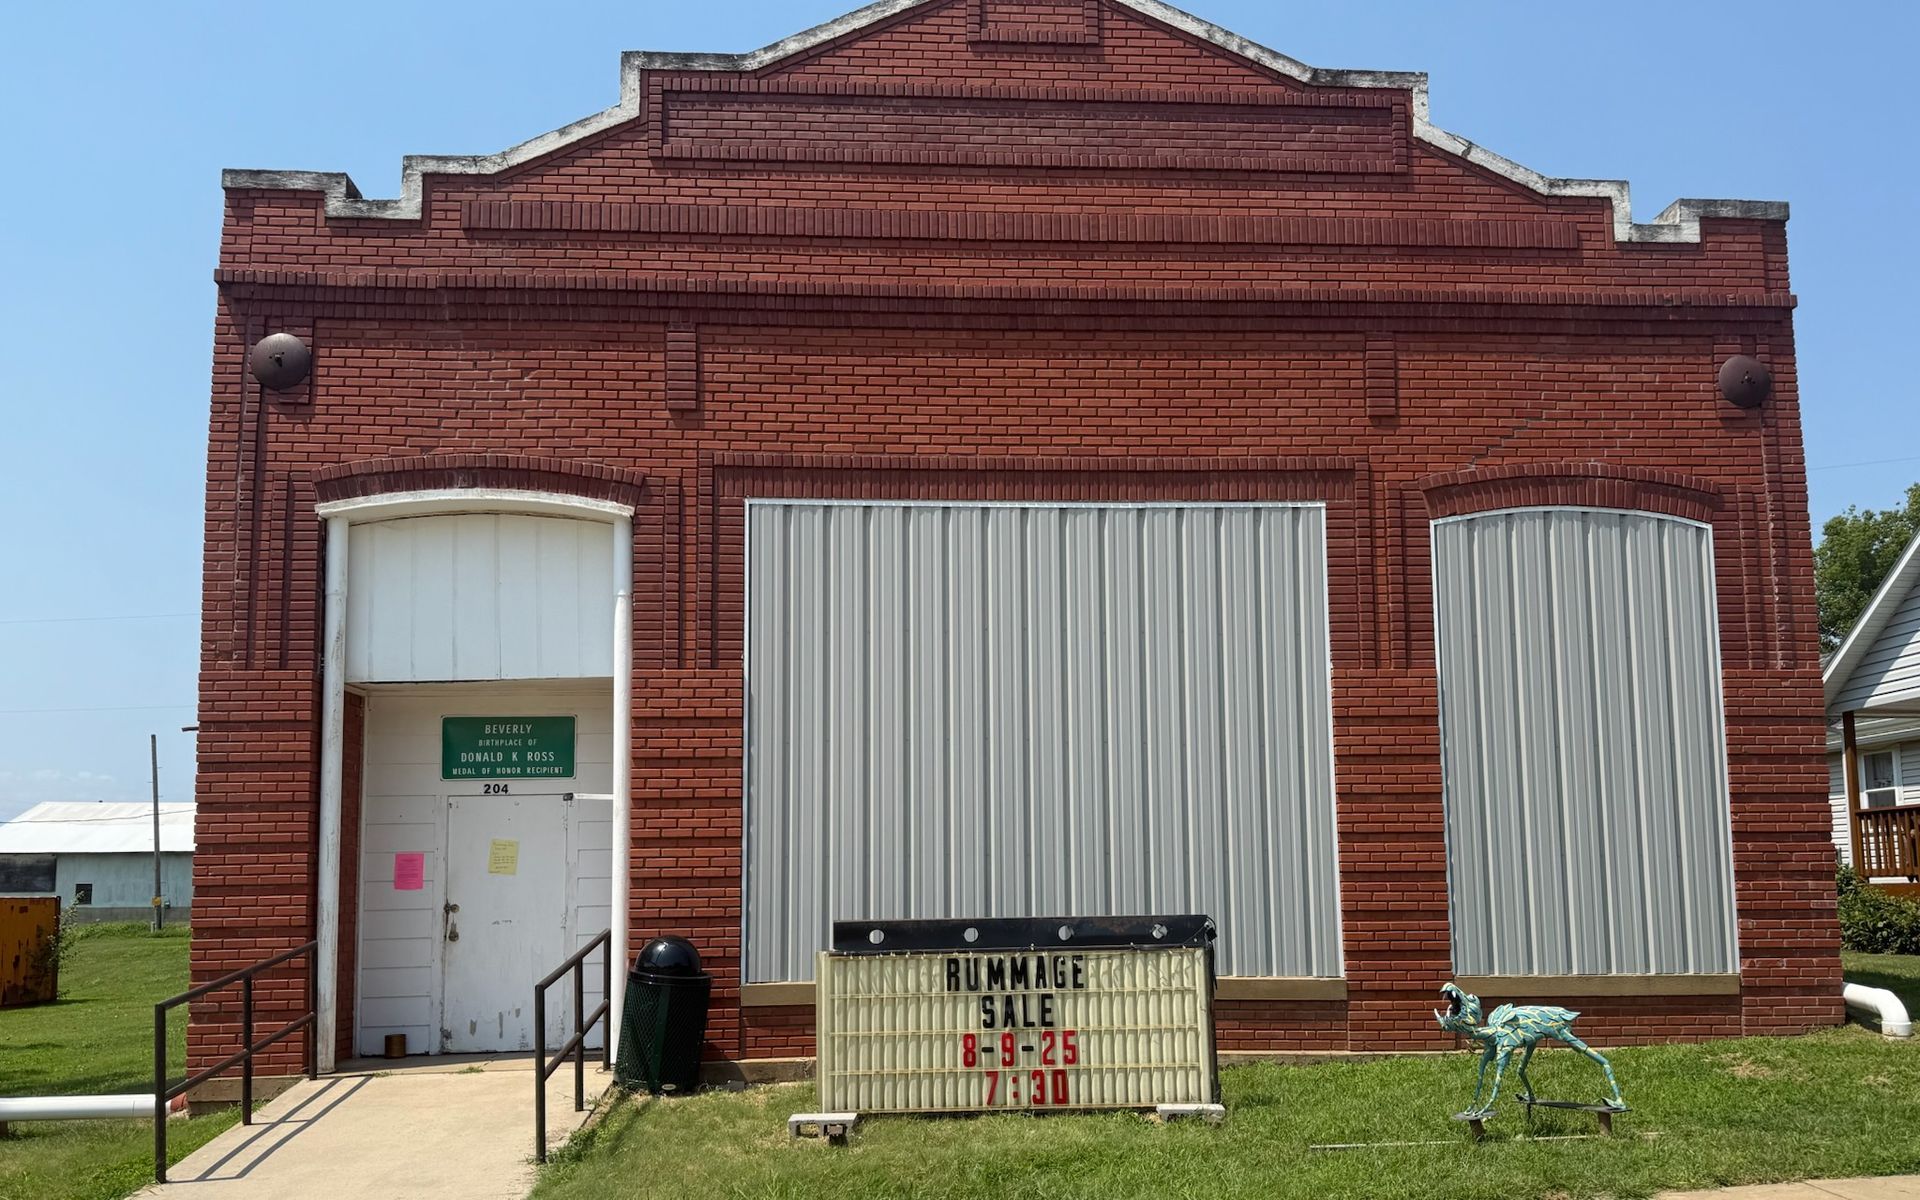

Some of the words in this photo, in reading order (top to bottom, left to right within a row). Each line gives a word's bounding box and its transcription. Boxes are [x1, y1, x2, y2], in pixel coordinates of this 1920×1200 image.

[484, 724, 533, 734] BEVERLY
[478, 739, 522, 747] BIRTHPLACE
[460, 752, 503, 762] DONALD
[511, 752, 518, 761] K
[527, 752, 555, 761] ROSS
[452, 767, 476, 775] MEDAL
[481, 767, 491, 775] OF
[526, 766, 563, 774] RECIPIENT
[483, 784, 509, 794] 204
[945, 955, 1085, 992] RUMMAGE
[981, 993, 1055, 1029] SALE
[962, 1030, 1078, 1068] 8-9-25
[985, 1069, 1069, 1106] 7:30
